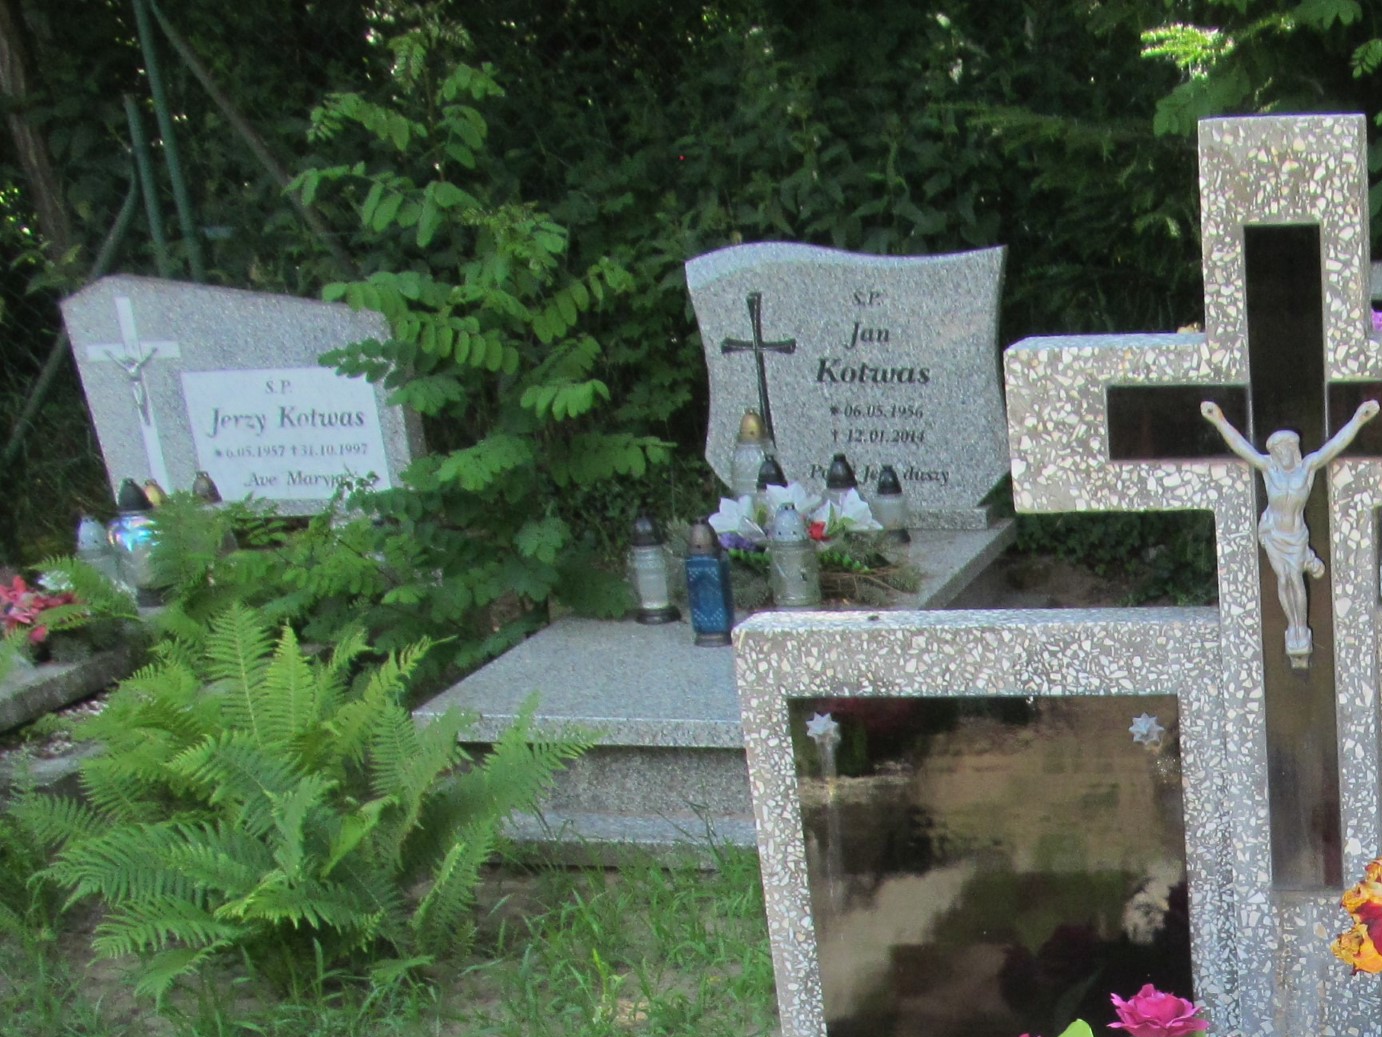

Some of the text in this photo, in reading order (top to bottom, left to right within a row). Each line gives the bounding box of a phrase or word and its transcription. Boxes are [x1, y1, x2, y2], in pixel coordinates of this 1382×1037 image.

[843, 321, 890, 350] Jan
[816, 358, 931, 385] Kotwas
[206, 405, 365, 438] Jerzy Kotwas
[244, 472, 277, 487] Ave
[904, 465, 950, 486] duszy
